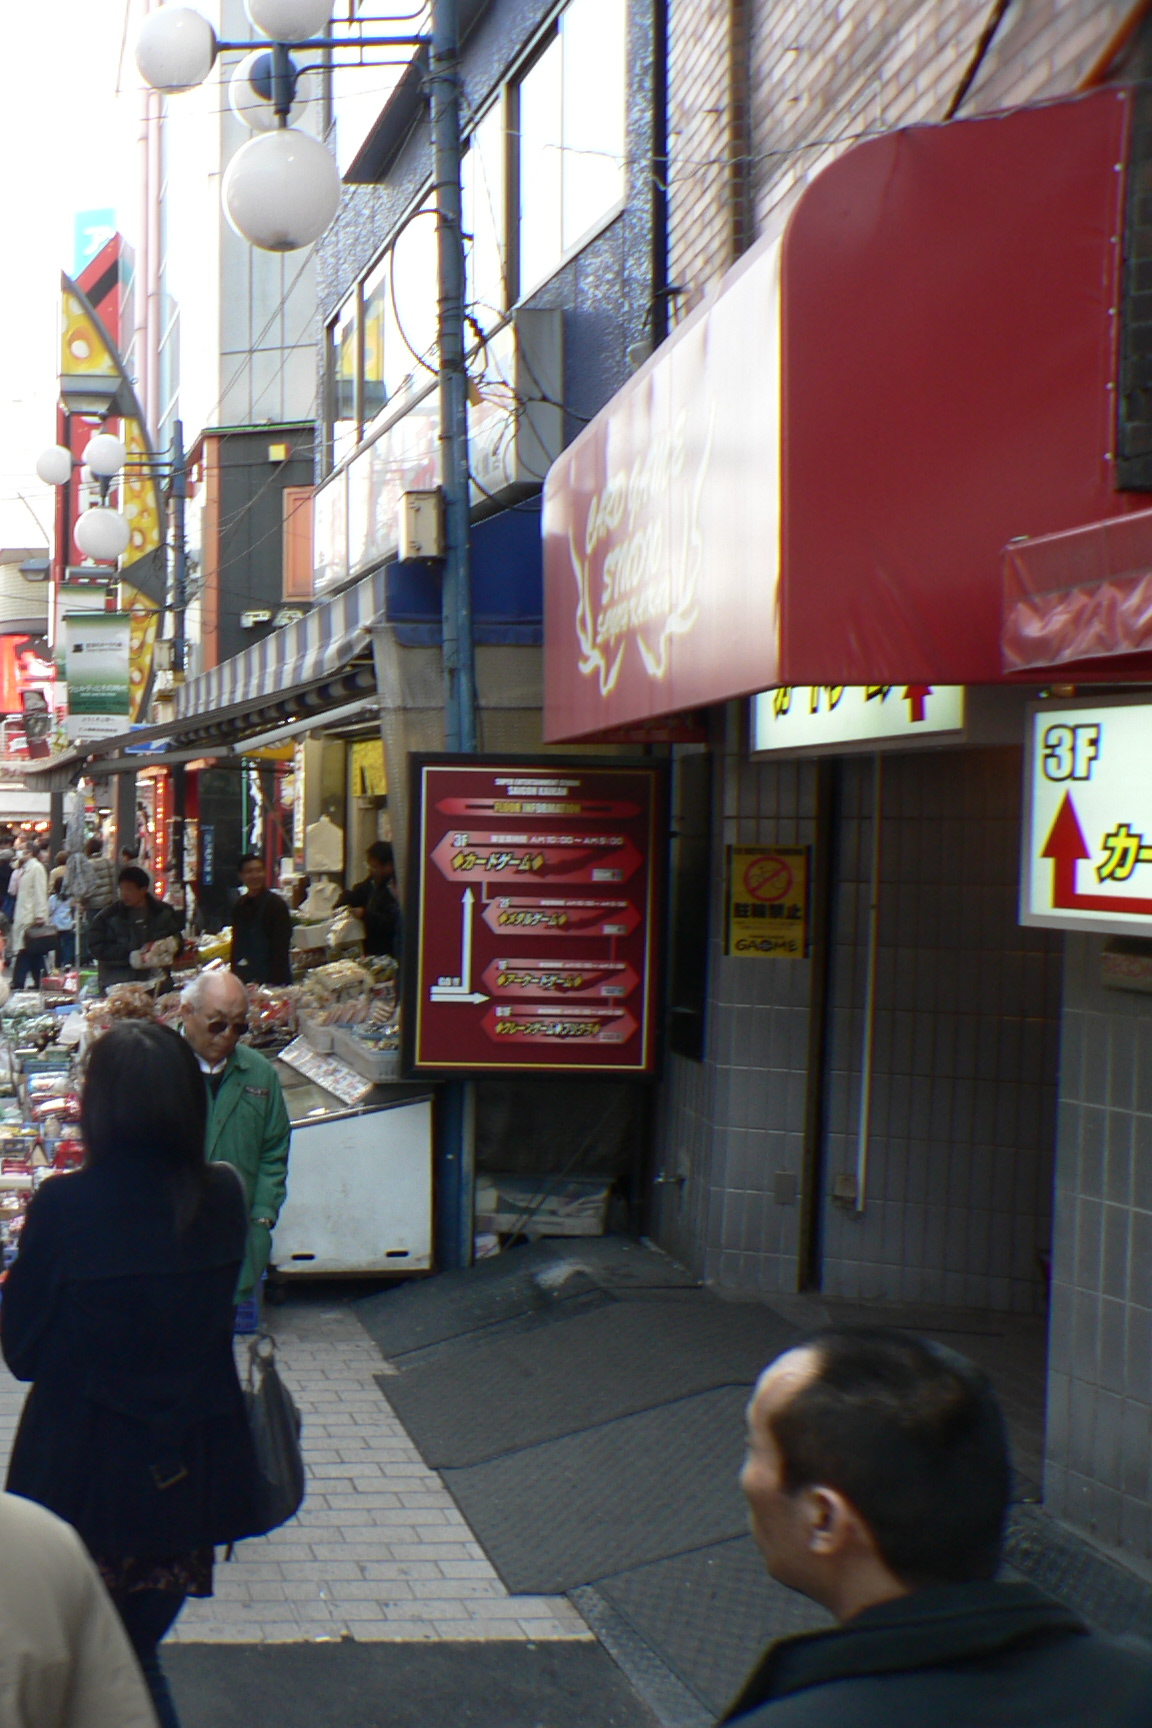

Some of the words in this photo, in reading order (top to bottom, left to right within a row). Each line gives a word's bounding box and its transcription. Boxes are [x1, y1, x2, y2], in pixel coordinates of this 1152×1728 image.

[1043, 723, 1101, 781] 3F
[453, 834, 468, 847] 3F
[462, 851, 532, 871] カードゲーム
[507, 912, 558, 926] メダルゲーム
[733, 902, 801, 920] 駐輪禁止
[505, 973, 574, 988] アーケードゲーム
